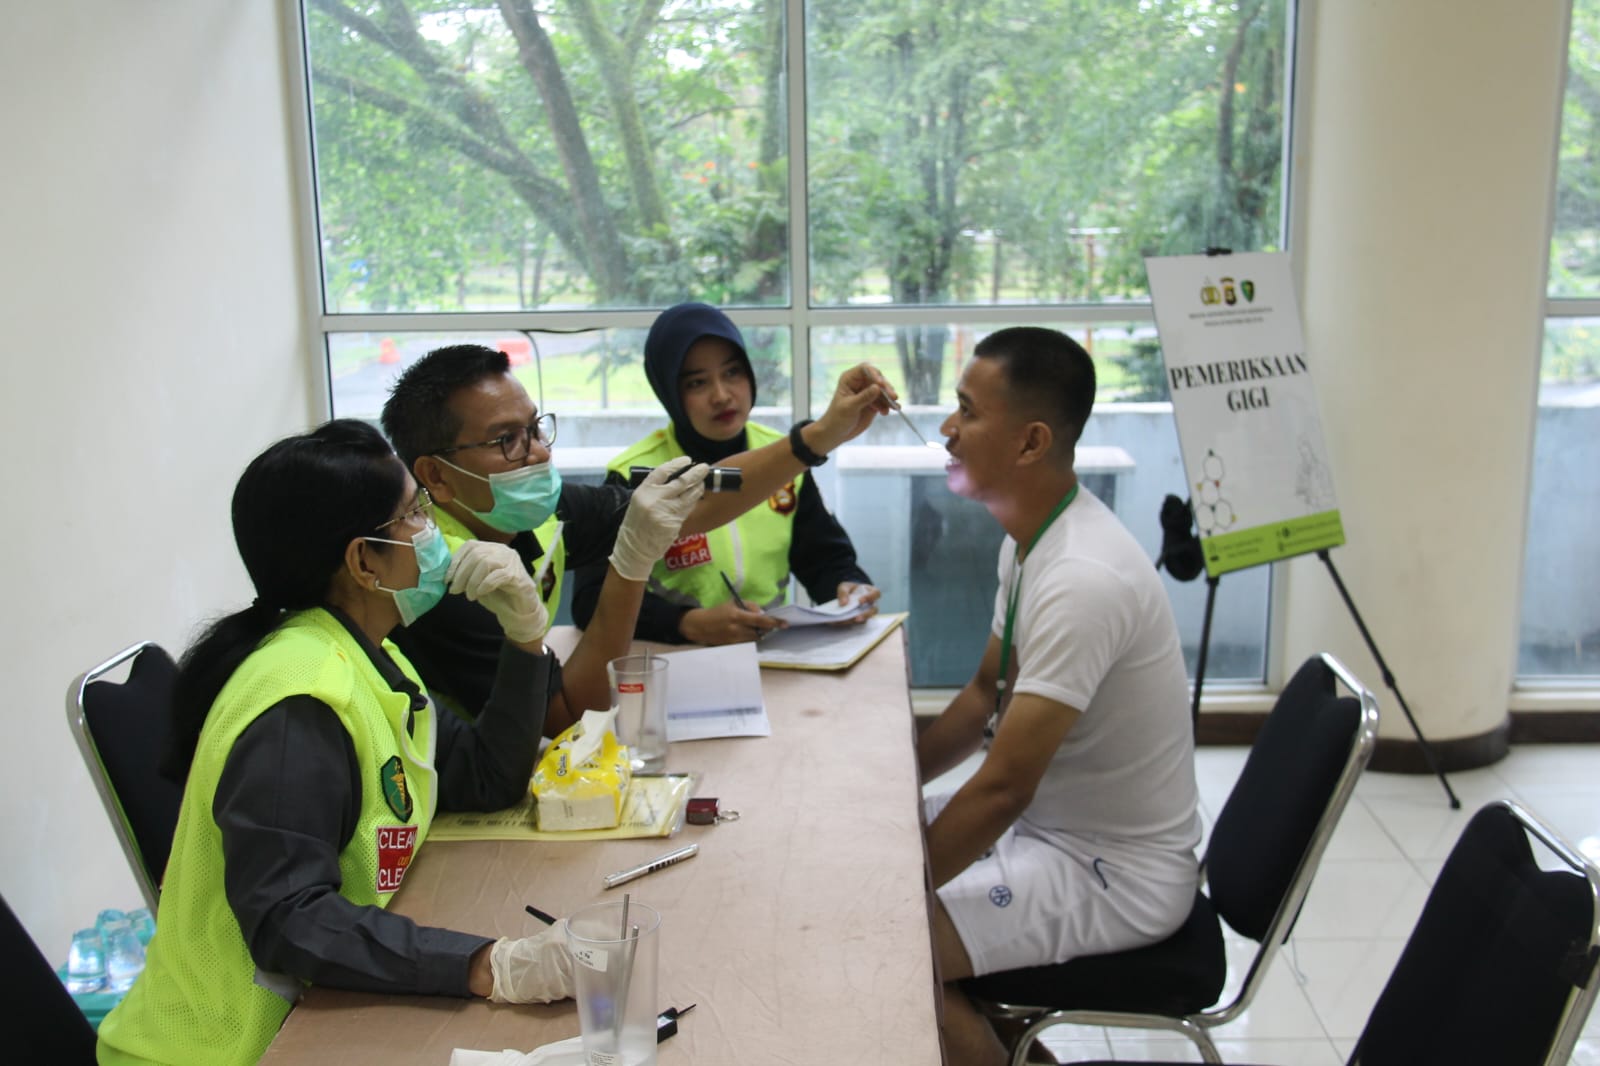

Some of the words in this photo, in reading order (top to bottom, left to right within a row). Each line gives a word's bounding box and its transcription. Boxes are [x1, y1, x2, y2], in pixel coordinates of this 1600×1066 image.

[1170, 354, 1308, 389] PEMERIKSAAN
[1227, 387, 1270, 412] GIGI
[667, 548, 710, 569] CLEAR
[378, 867, 404, 887] CLE
